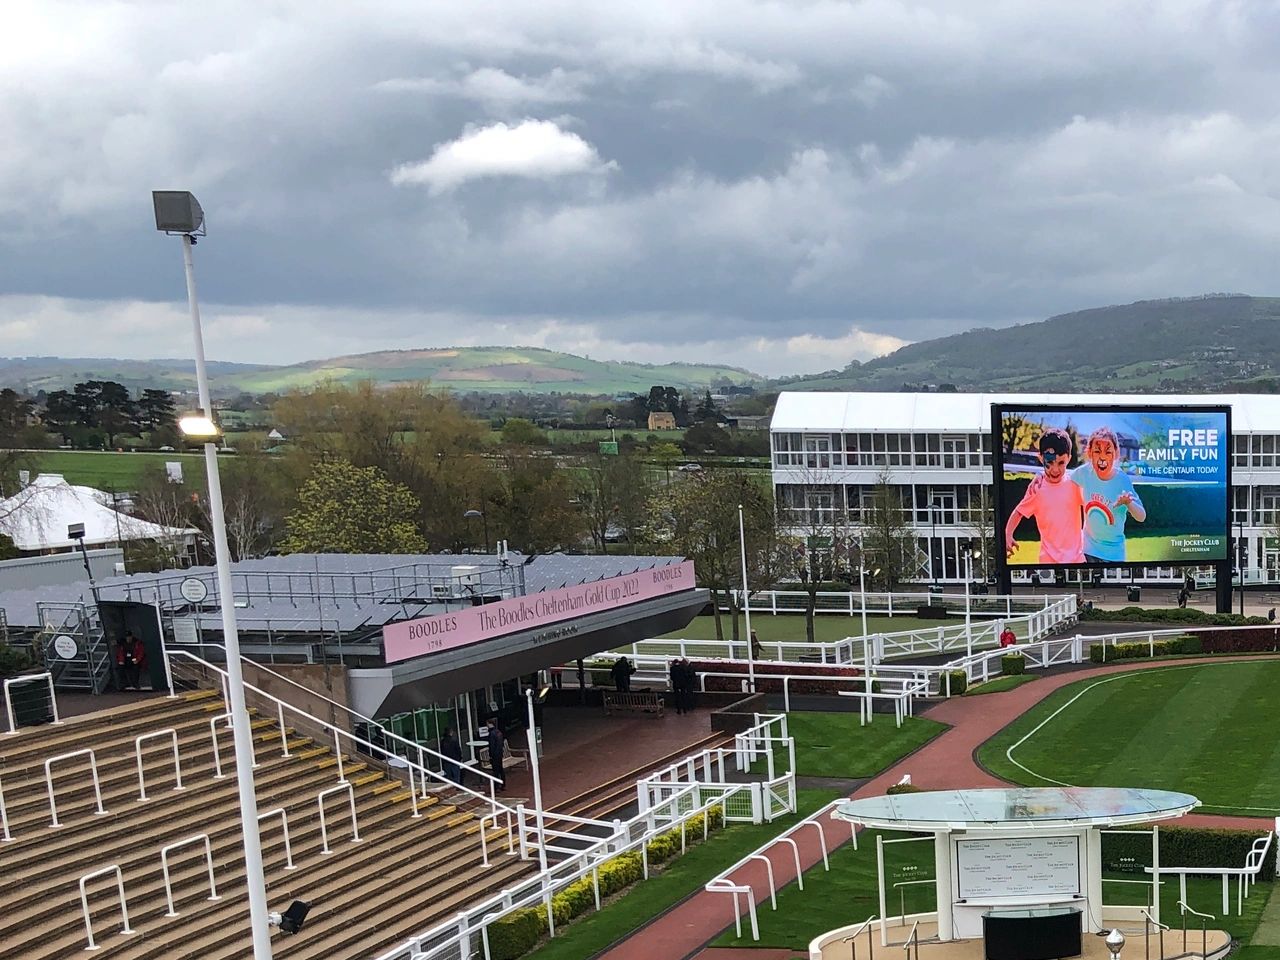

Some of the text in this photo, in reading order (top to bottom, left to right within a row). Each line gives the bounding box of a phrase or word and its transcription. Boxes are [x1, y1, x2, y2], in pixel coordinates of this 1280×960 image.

[1168, 429, 1218, 447] FREE
[1138, 448, 1218, 461] FAMILY FUN
[1138, 466, 1219, 474] IN THE CENTAUR TODAY
[652, 566, 682, 583] BOODLES
[477, 578, 640, 631] The Boodles Cheltenham Gold Cup 2022
[408, 616, 458, 640] BOODLES
